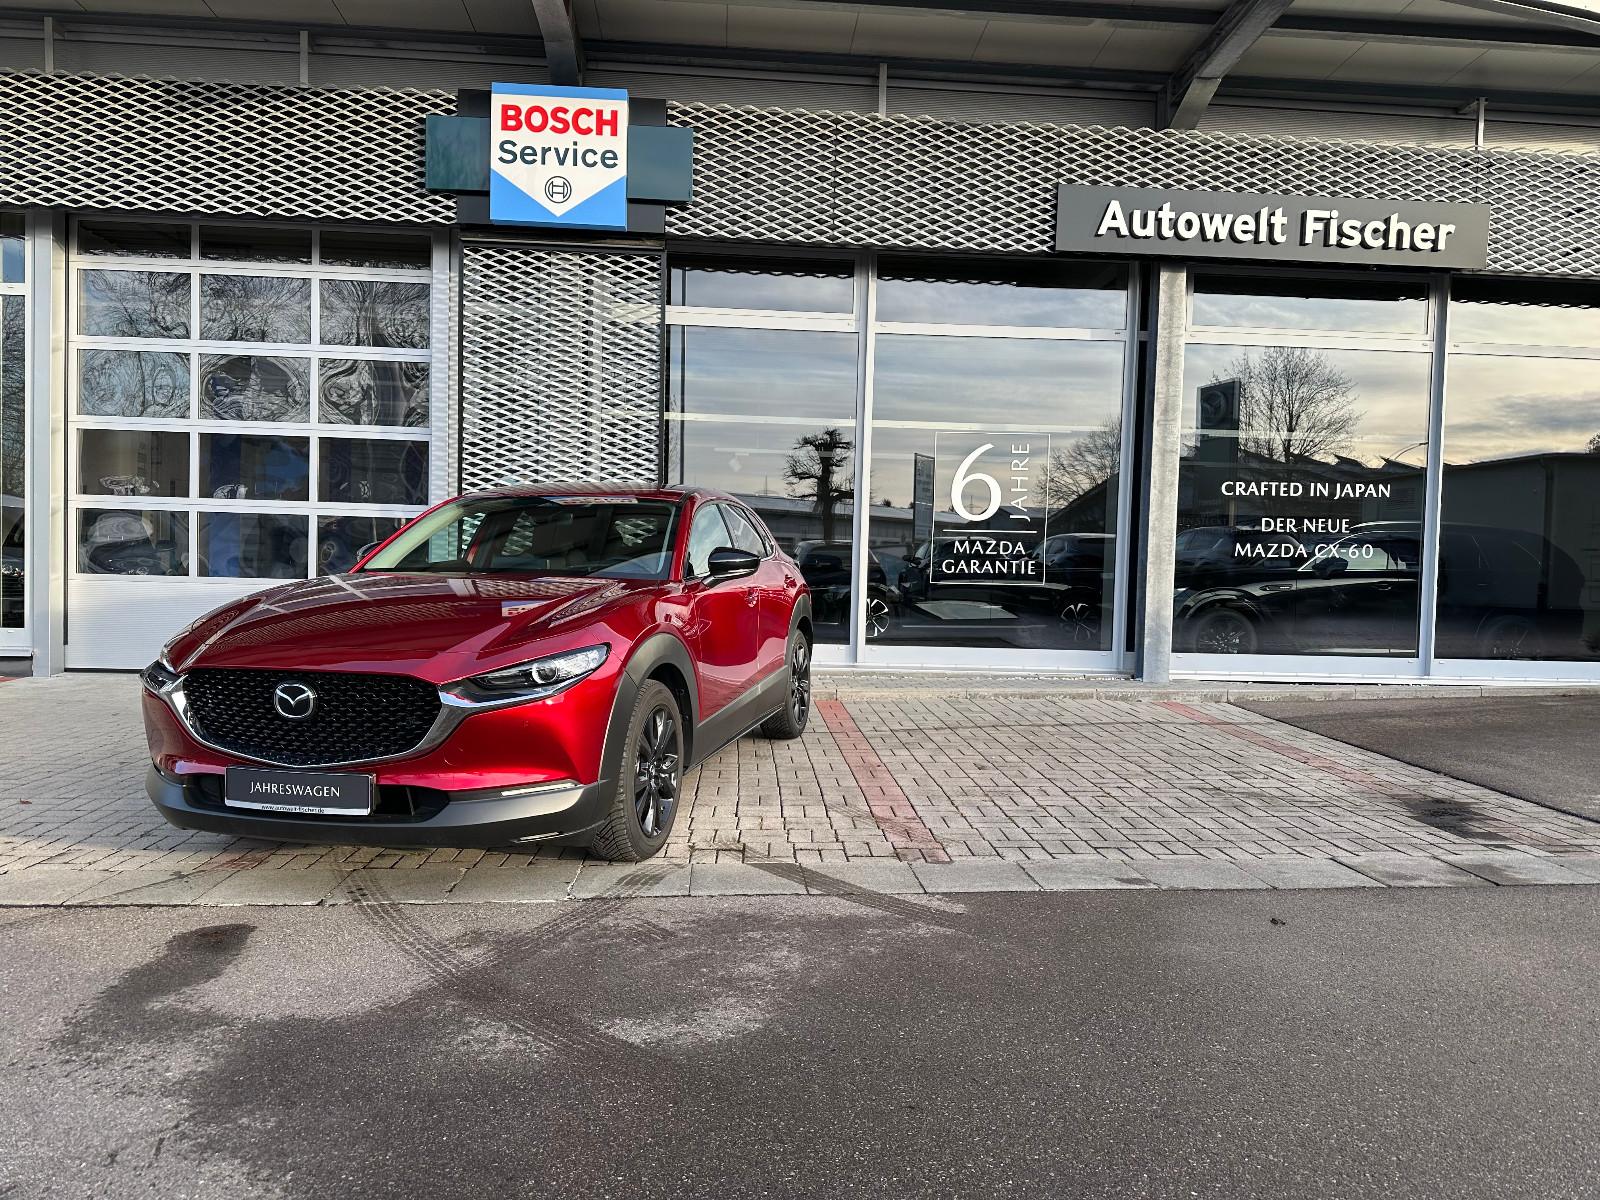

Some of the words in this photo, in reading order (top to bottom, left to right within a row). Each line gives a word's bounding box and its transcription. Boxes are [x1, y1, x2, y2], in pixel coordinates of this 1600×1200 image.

[501, 103, 618, 137] BOSCH
[498, 140, 619, 168] Service
[1096, 199, 1288, 244] Autowelt
[1303, 209, 1456, 251] Fischer
[951, 443, 1001, 521] 6
[1009, 443, 1030, 522] JAHRE
[1221, 481, 1303, 497] CRAFTED
[1310, 482, 1329, 497] IN
[1334, 483, 1391, 499] JAPAN
[1261, 517, 1298, 533] DER
[1303, 518, 1350, 533] NEUE
[953, 540, 1026, 555] MAZDA
[1234, 543, 1308, 558] MAZDA
[1314, 543, 1374, 559] CX-60
[941, 559, 1036, 575] GARANTIE
[249, 781, 340, 798] JAHRESWAGEN
